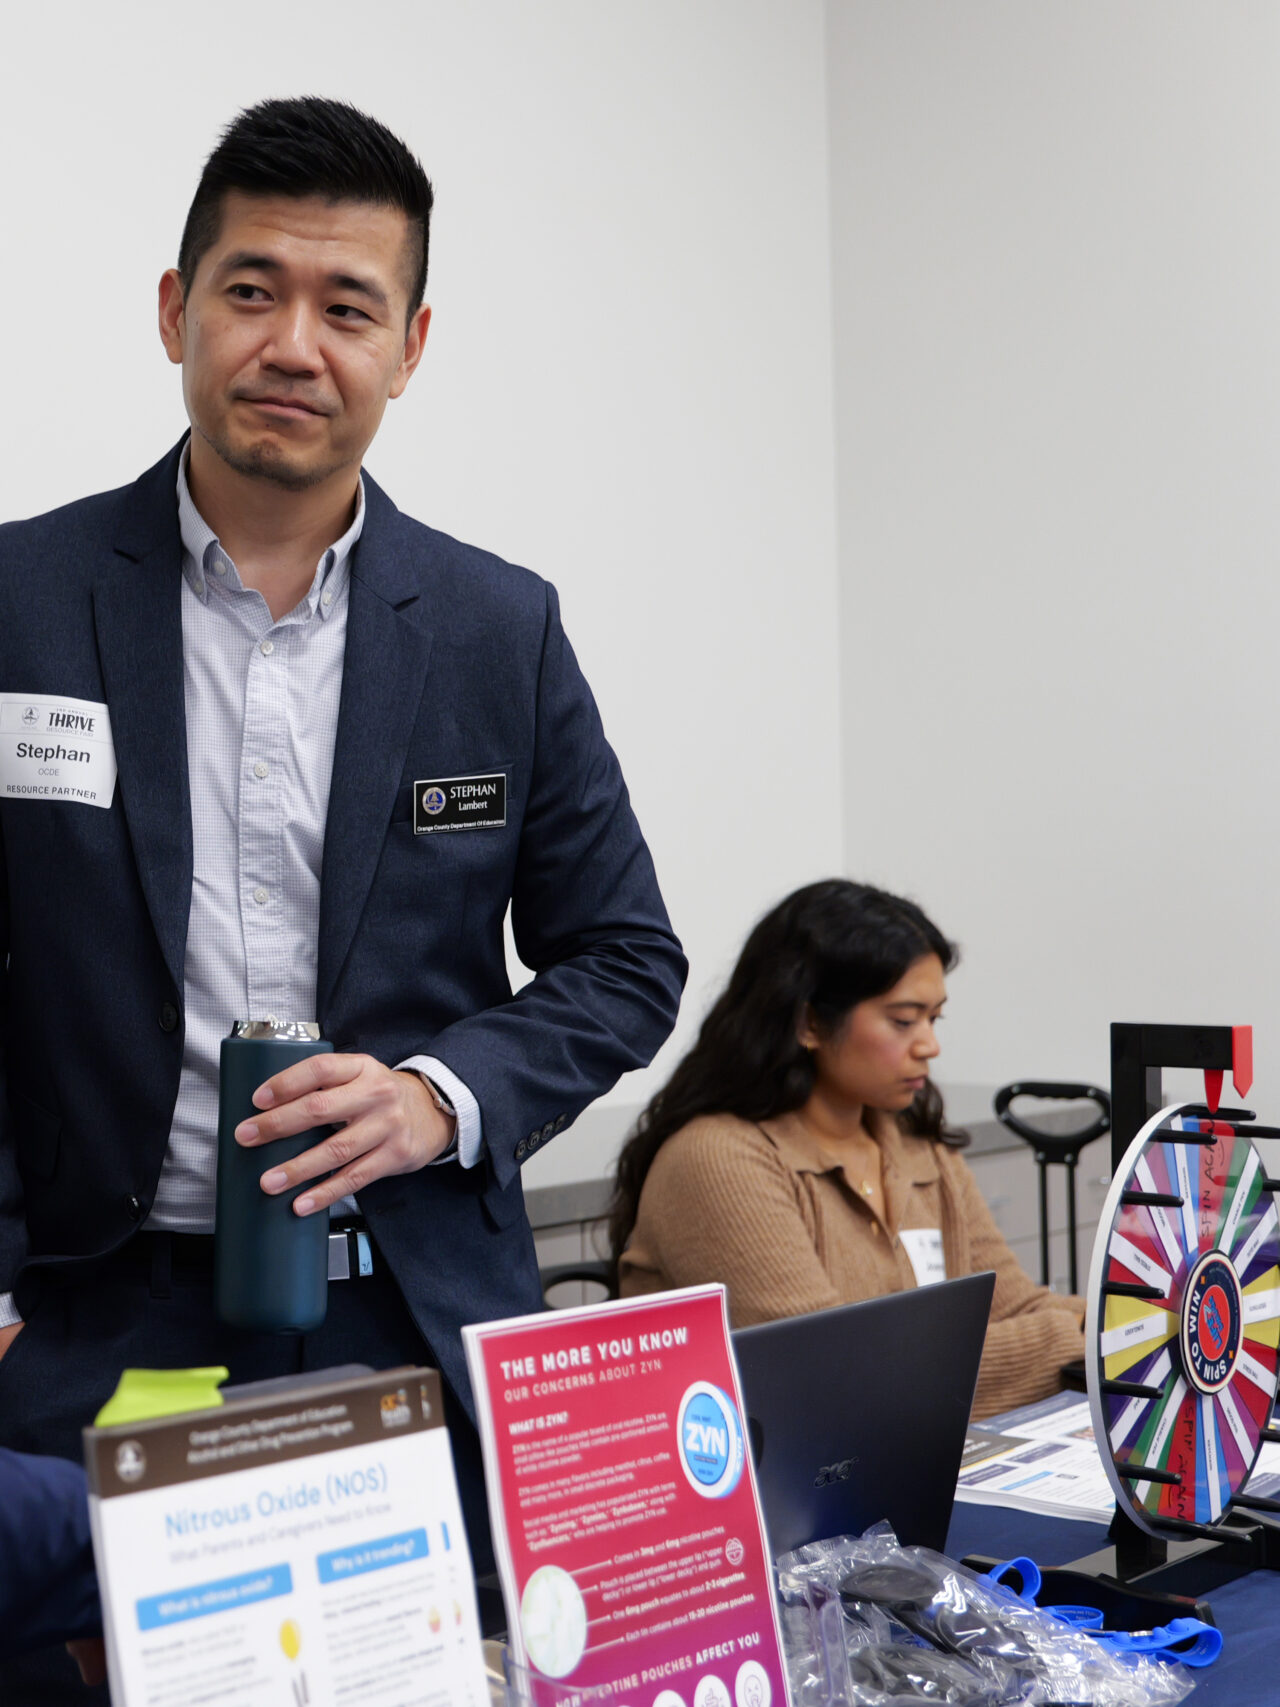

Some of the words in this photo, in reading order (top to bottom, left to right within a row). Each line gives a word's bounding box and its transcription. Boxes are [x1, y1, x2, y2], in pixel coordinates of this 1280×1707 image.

[49, 712, 96, 732] THRIVE
[16, 742, 90, 763] Stephan
[38, 768, 60, 776] OCDE
[6, 784, 49, 794] RESOURCE
[52, 786, 96, 800] PARTNER
[450, 784, 496, 798] STEPHAN
[458, 801, 488, 811] Lambert
[1201, 1190, 1212, 1237] SPIN
[1190, 1290, 1200, 1333] WIN
[501, 1356, 535, 1380] THE
[541, 1345, 591, 1372] MORE
[597, 1337, 632, 1361] YOU
[639, 1327, 688, 1353] KNOW
[1192, 1342, 1203, 1370] TO
[504, 1385, 529, 1403] OUR
[532, 1372, 595, 1397] CONCERNS
[597, 1364, 636, 1383] ABOUT
[640, 1358, 662, 1374] ZYN
[1203, 1360, 1226, 1380] SPIN
[189, 1427, 219, 1445] Orange
[221, 1421, 250, 1439] County
[250, 1412, 298, 1433] Department
[307, 1402, 346, 1422] Education
[260, 1434, 280, 1450] Drug
[320, 1419, 353, 1438] Program
[509, 1418, 535, 1436] WHAT
[536, 1416, 545, 1430] IS
[545, 1411, 569, 1428] ZYN?
[686, 1422, 726, 1456] ZYN
[164, 1502, 250, 1538] Nitrous
[256, 1483, 321, 1519] Oxide
[325, 1463, 388, 1505] (NOS)
[332, 1555, 354, 1573] Why
[373, 1539, 416, 1563] trending?
[614, 1551, 633, 1564] Comes
[680, 1532, 701, 1545] nicotine
[702, 1525, 725, 1539] pouches
[624, 1569, 644, 1583] placed
[644, 1562, 668, 1577] between
[158, 1597, 188, 1618] What
[201, 1584, 238, 1607] nitrous
[640, 1597, 660, 1611] pouch
[689, 1583, 705, 1596] about
[649, 1619, 672, 1634] contains
[673, 1613, 689, 1627] about
[706, 1600, 729, 1616] nicotine
[730, 1592, 755, 1608] pouches
[640, 1655, 692, 1684] POUCHES
[694, 1640, 736, 1665] AFFECT
[738, 1631, 760, 1650] YOU
